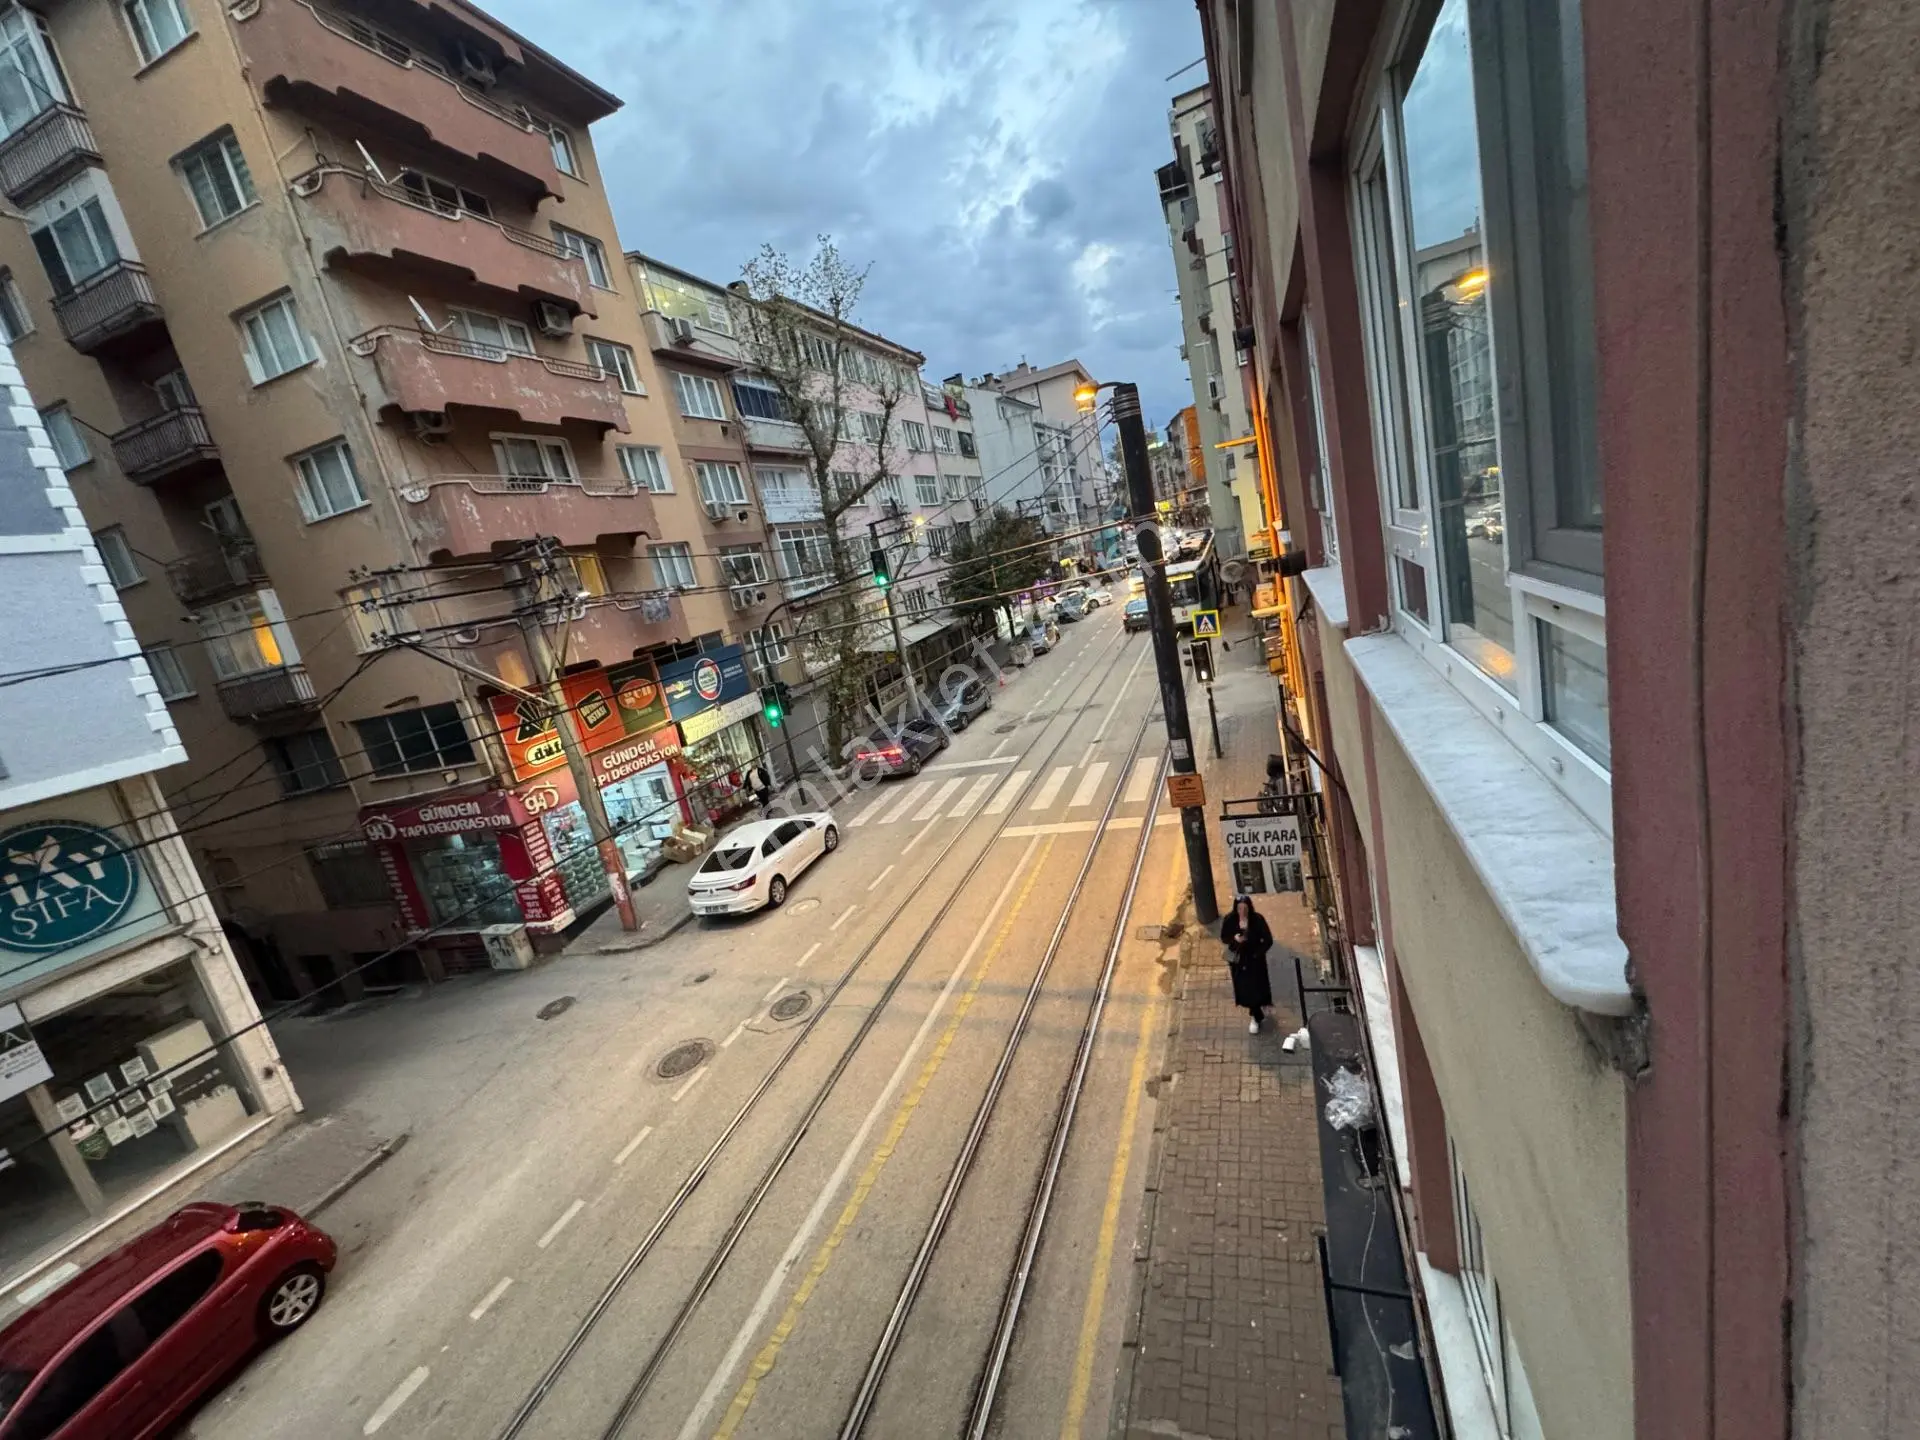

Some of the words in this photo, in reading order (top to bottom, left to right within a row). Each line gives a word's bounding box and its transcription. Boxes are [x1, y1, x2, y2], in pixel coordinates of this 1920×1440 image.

[534, 740, 564, 762] düf
[602, 739, 656, 770] GÜNDEM
[611, 743, 679, 779] DEKORASYON
[418, 801, 481, 822] GÜNDEM
[428, 814, 511, 834] DEKORASYON
[1226, 831, 1260, 847] ÇELİK
[1264, 828, 1298, 842] PARA
[1233, 844, 1295, 858] KASALARI
